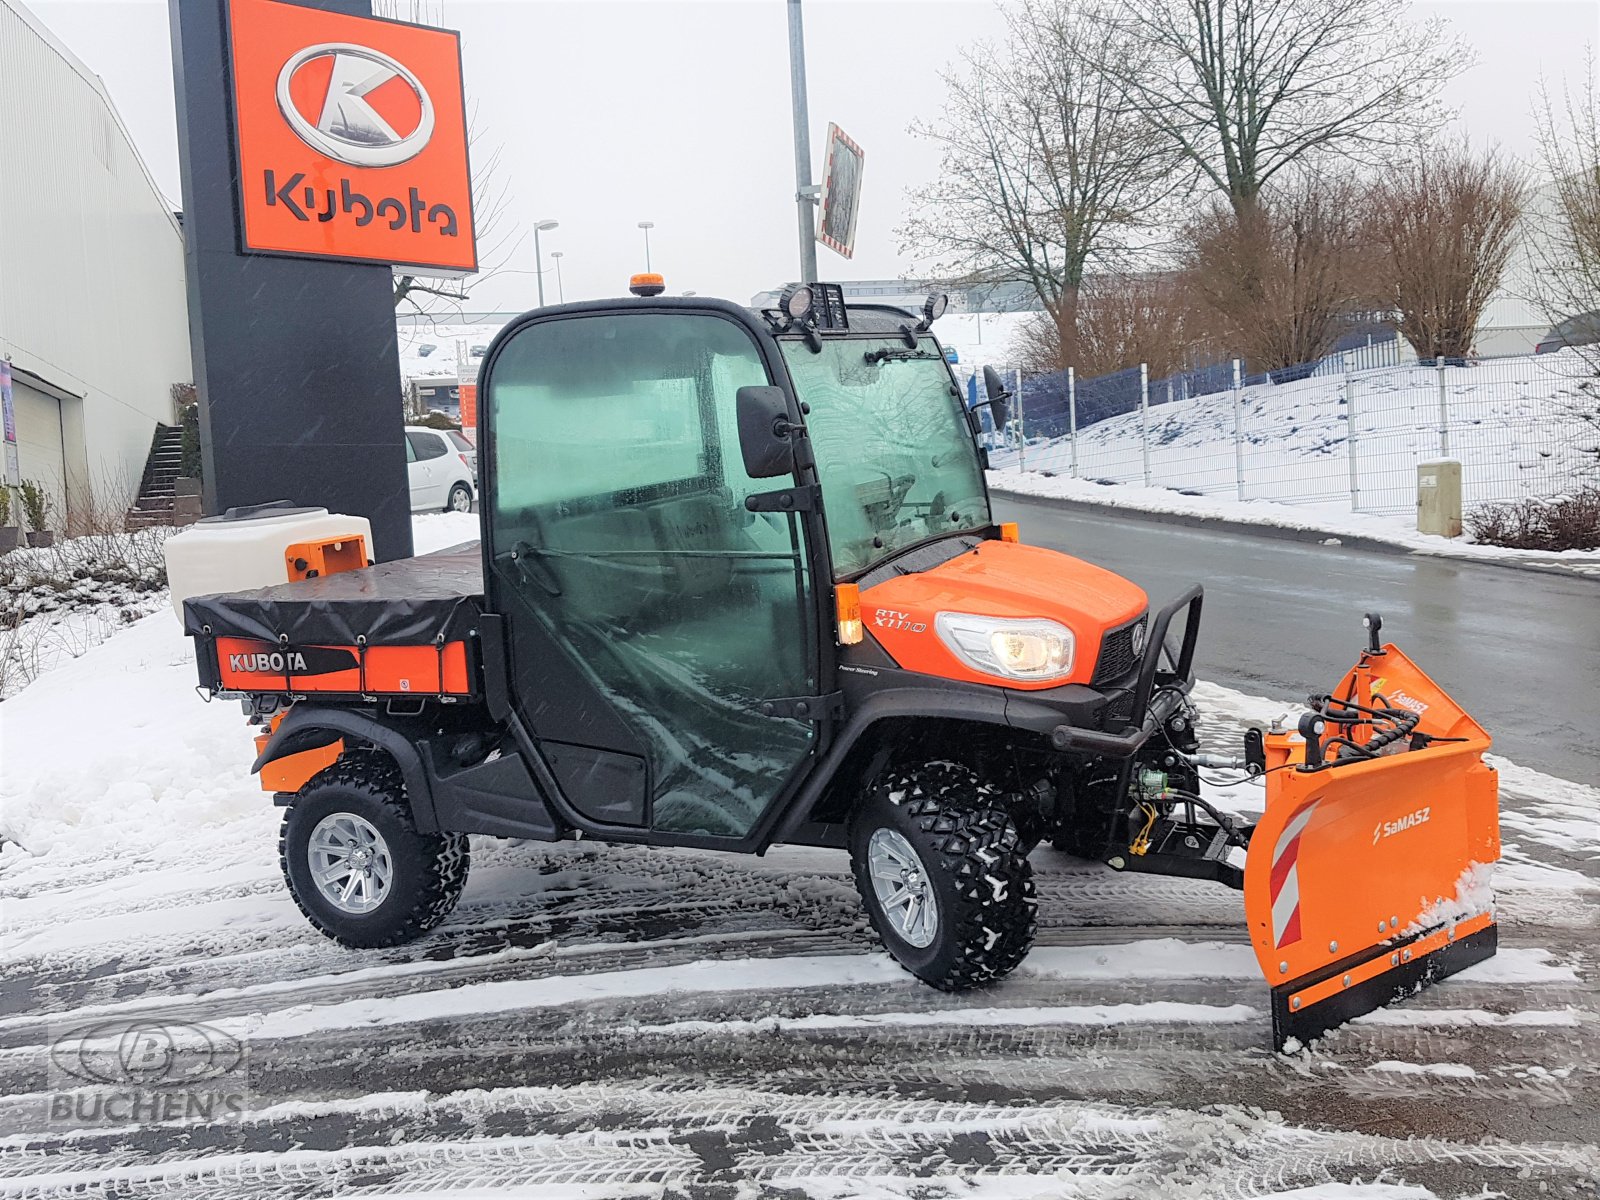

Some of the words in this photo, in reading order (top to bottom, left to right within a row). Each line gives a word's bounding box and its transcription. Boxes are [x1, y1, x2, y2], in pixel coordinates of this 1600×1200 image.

[263, 168, 458, 238] Kubota
[875, 608, 909, 620] RTV
[229, 652, 308, 673] KUBOTA
[838, 664, 855, 672] Power
[855, 667, 879, 676] Steering
[1383, 806, 1431, 838] SaMASZ
